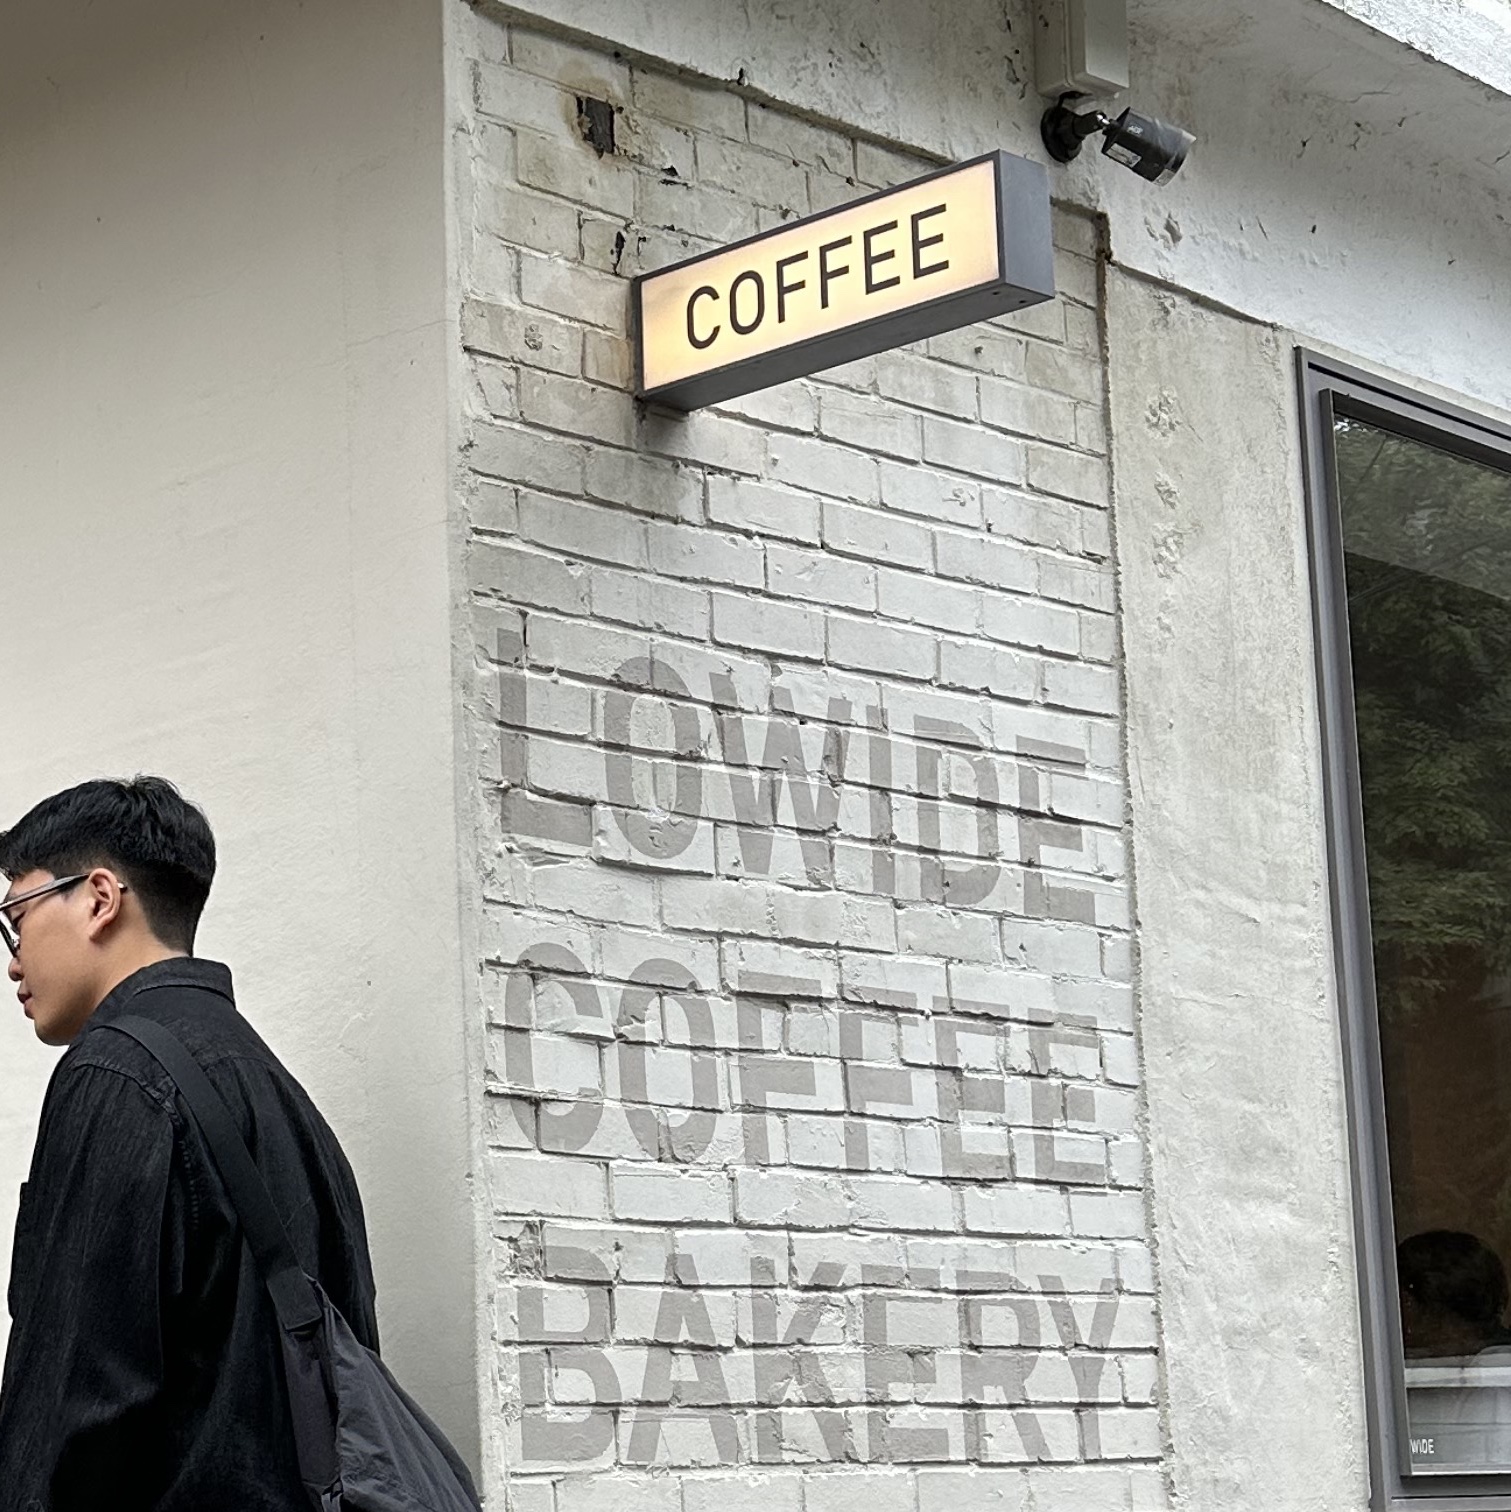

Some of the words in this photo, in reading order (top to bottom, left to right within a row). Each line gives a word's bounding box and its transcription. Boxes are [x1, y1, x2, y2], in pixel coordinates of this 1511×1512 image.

[686, 204, 950, 349] COFFEE
[496, 628, 1096, 925] LOWIDE
[504, 942, 1108, 1196] COFFEE
[515, 1245, 1121, 1463] BAKERY
